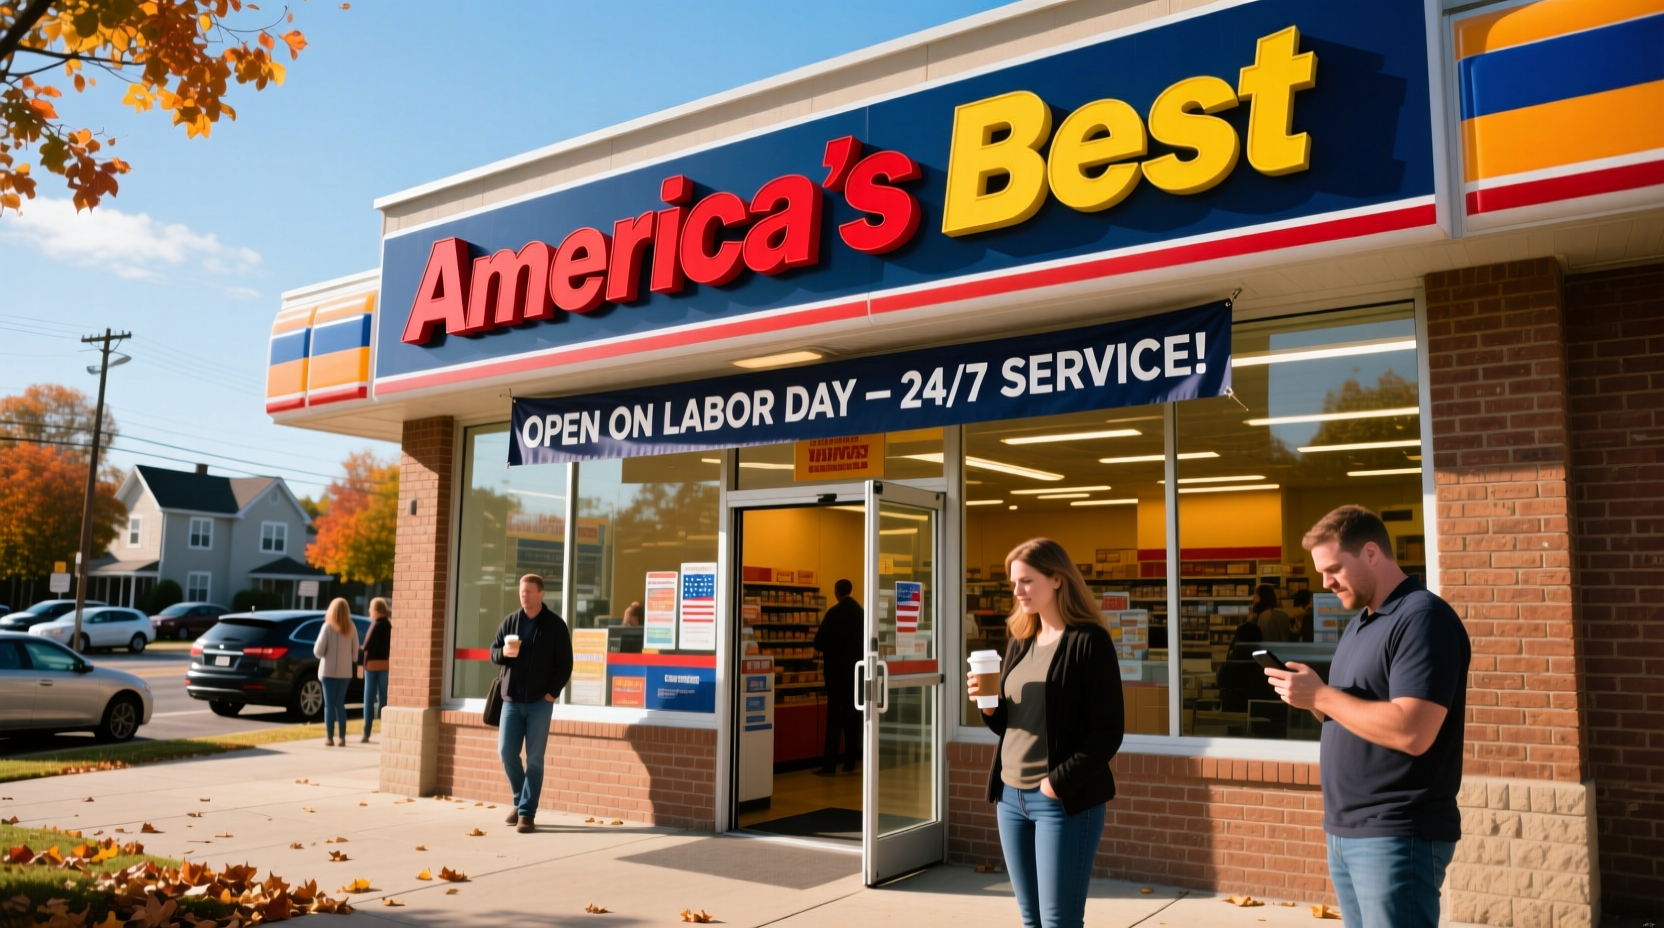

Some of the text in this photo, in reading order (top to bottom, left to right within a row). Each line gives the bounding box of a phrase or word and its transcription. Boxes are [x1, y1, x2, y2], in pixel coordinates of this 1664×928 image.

[402, 25, 1318, 345] America's Best
[521, 410, 601, 449] OPEN
[608, 402, 654, 441] ON
[663, 388, 775, 436] LABOR
[784, 378, 858, 423] DAY
[899, 362, 989, 409] 24/7
[999, 331, 1207, 398] SERVICE!
